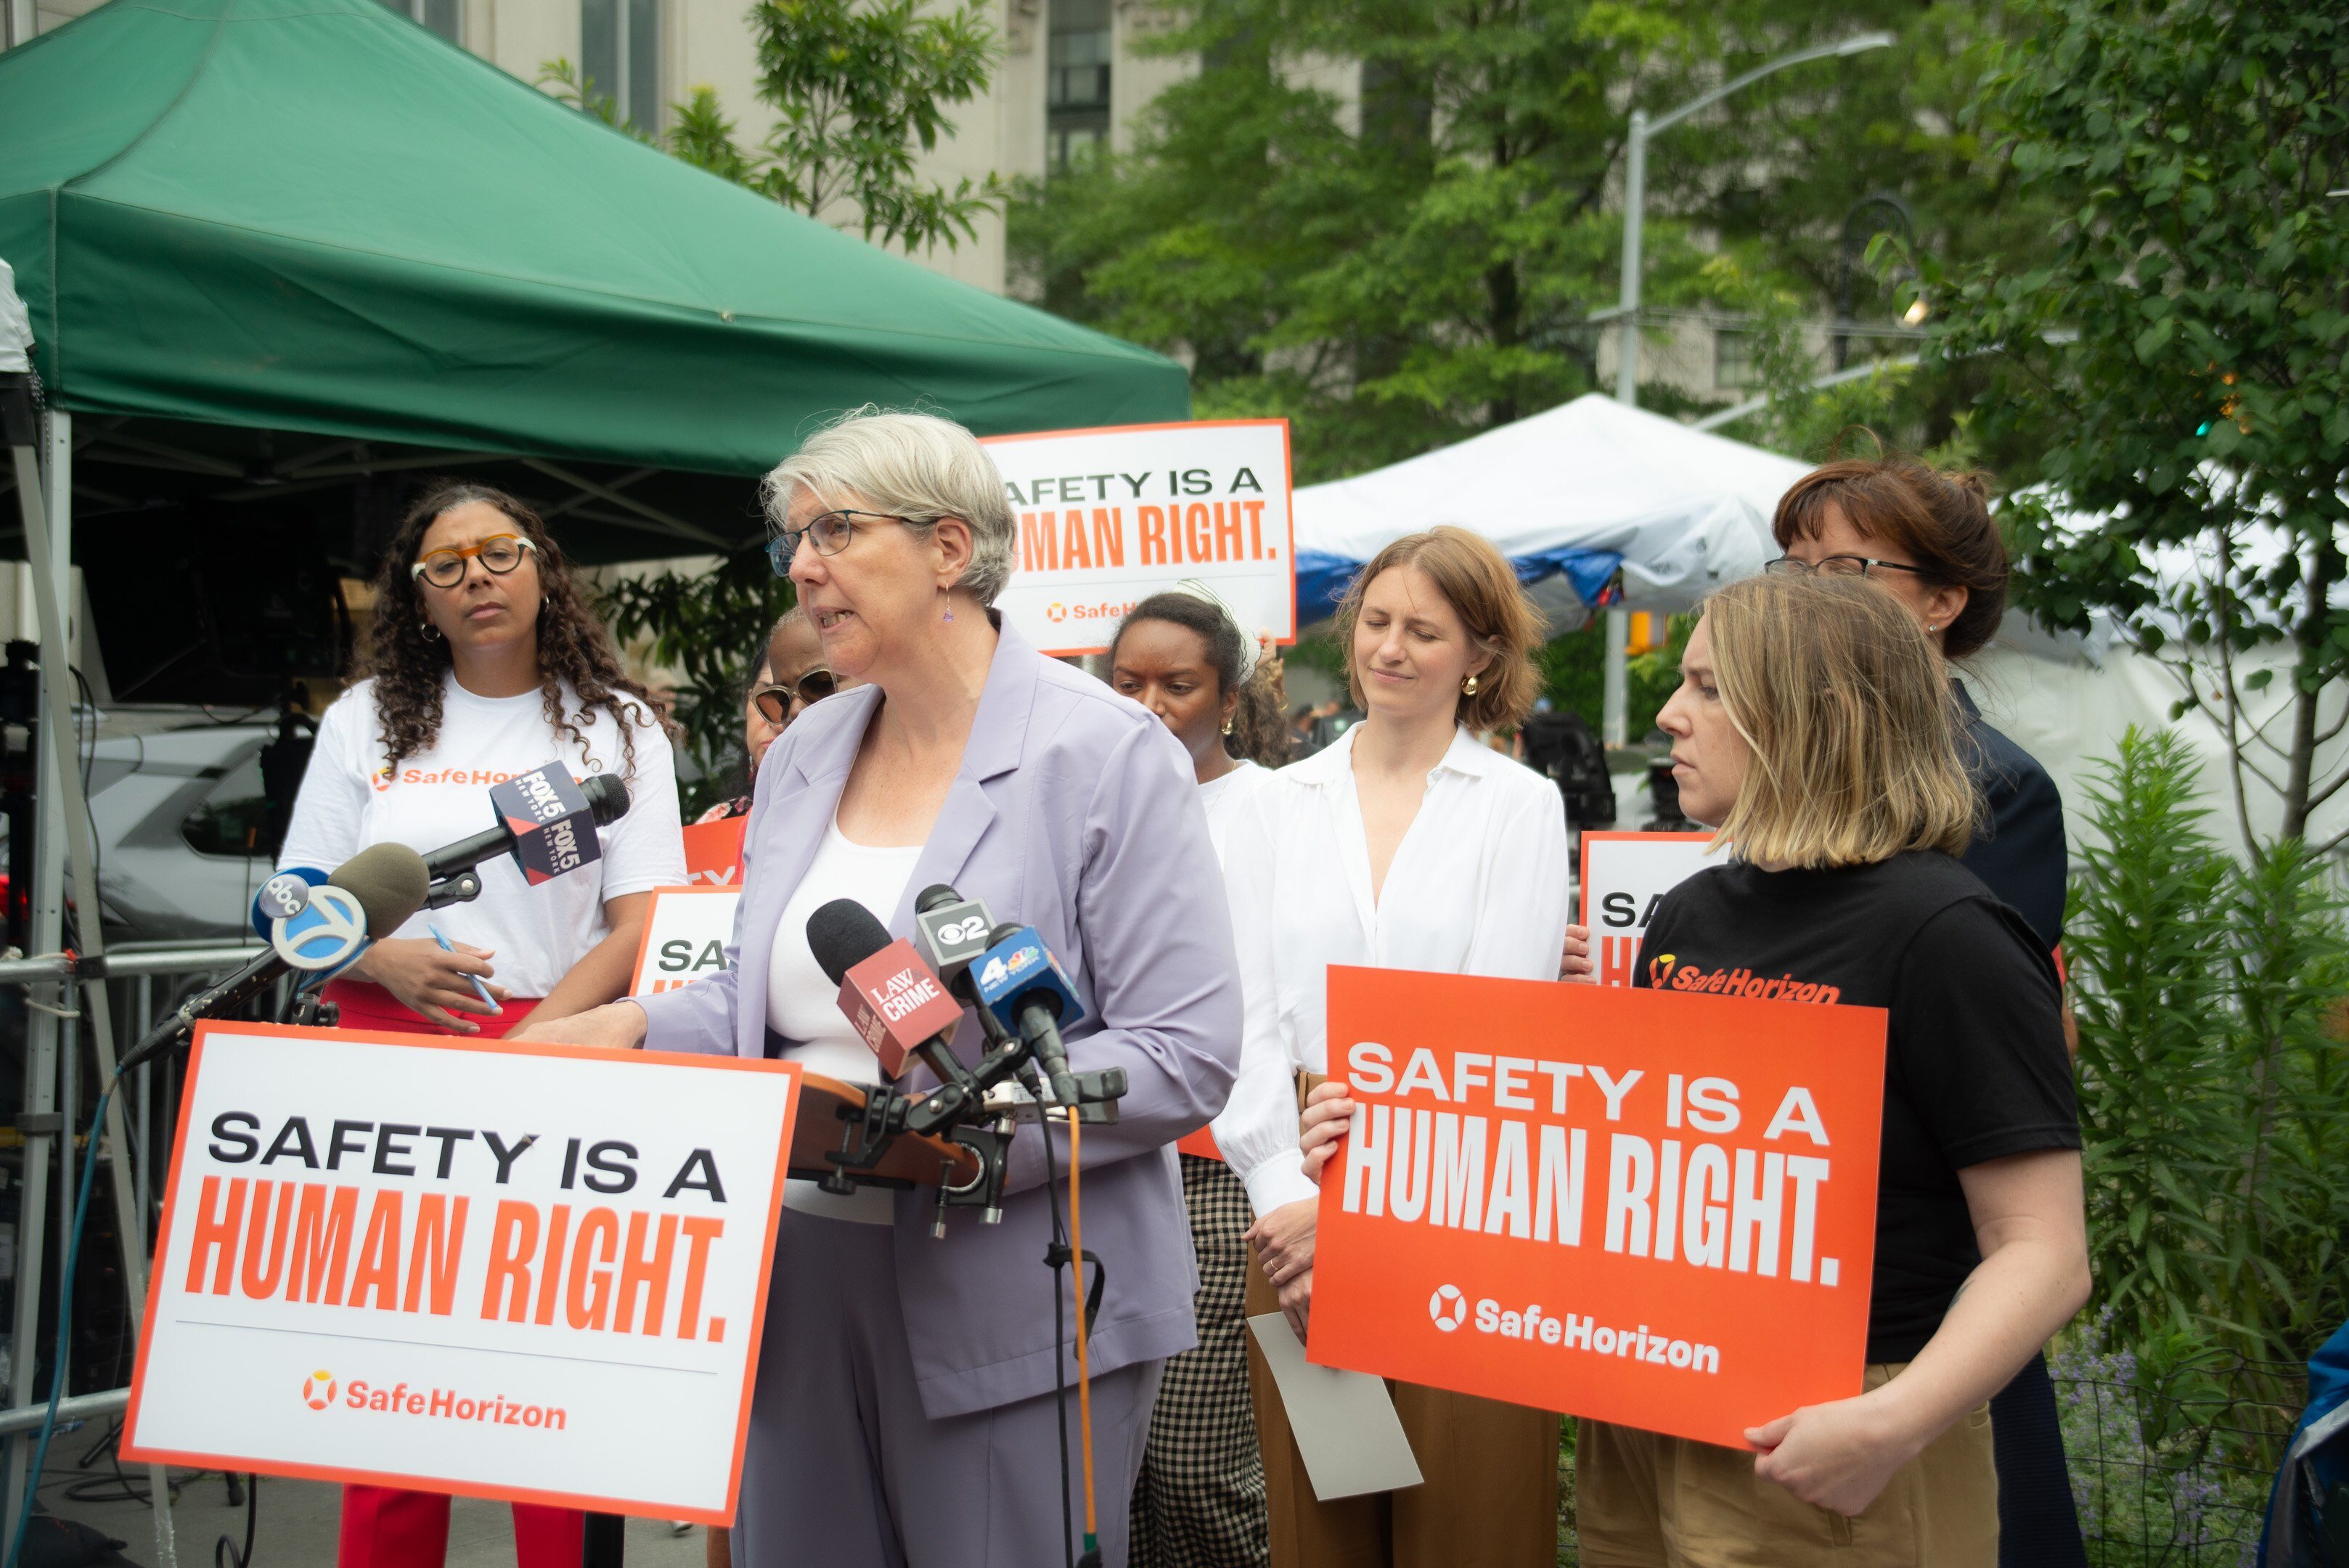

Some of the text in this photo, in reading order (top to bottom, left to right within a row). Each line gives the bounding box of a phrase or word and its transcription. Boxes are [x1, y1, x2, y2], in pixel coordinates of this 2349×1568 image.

[1005, 467, 1264, 506] AFETY IS A
[1013, 499, 1278, 572] MAN RIGHT.
[515, 779, 531, 797] NEW
[528, 799, 546, 822] YORK
[544, 827, 554, 846] NEW
[550, 849, 560, 874] YORK
[268, 878, 301, 915] abc
[980, 956, 1008, 986] 4
[882, 977, 940, 1021] CRIME
[1347, 1042, 1830, 1146] SAFETY IS A
[208, 1111, 727, 1203] SAFETY IS A
[1342, 1102, 1840, 1287] HUMAN RIGHT.
[184, 1175, 726, 1343] HUMAN RIGHT.
[1474, 1298, 1720, 1374] SafeHorizon
[346, 1380, 566, 1430] SafeHorizon
